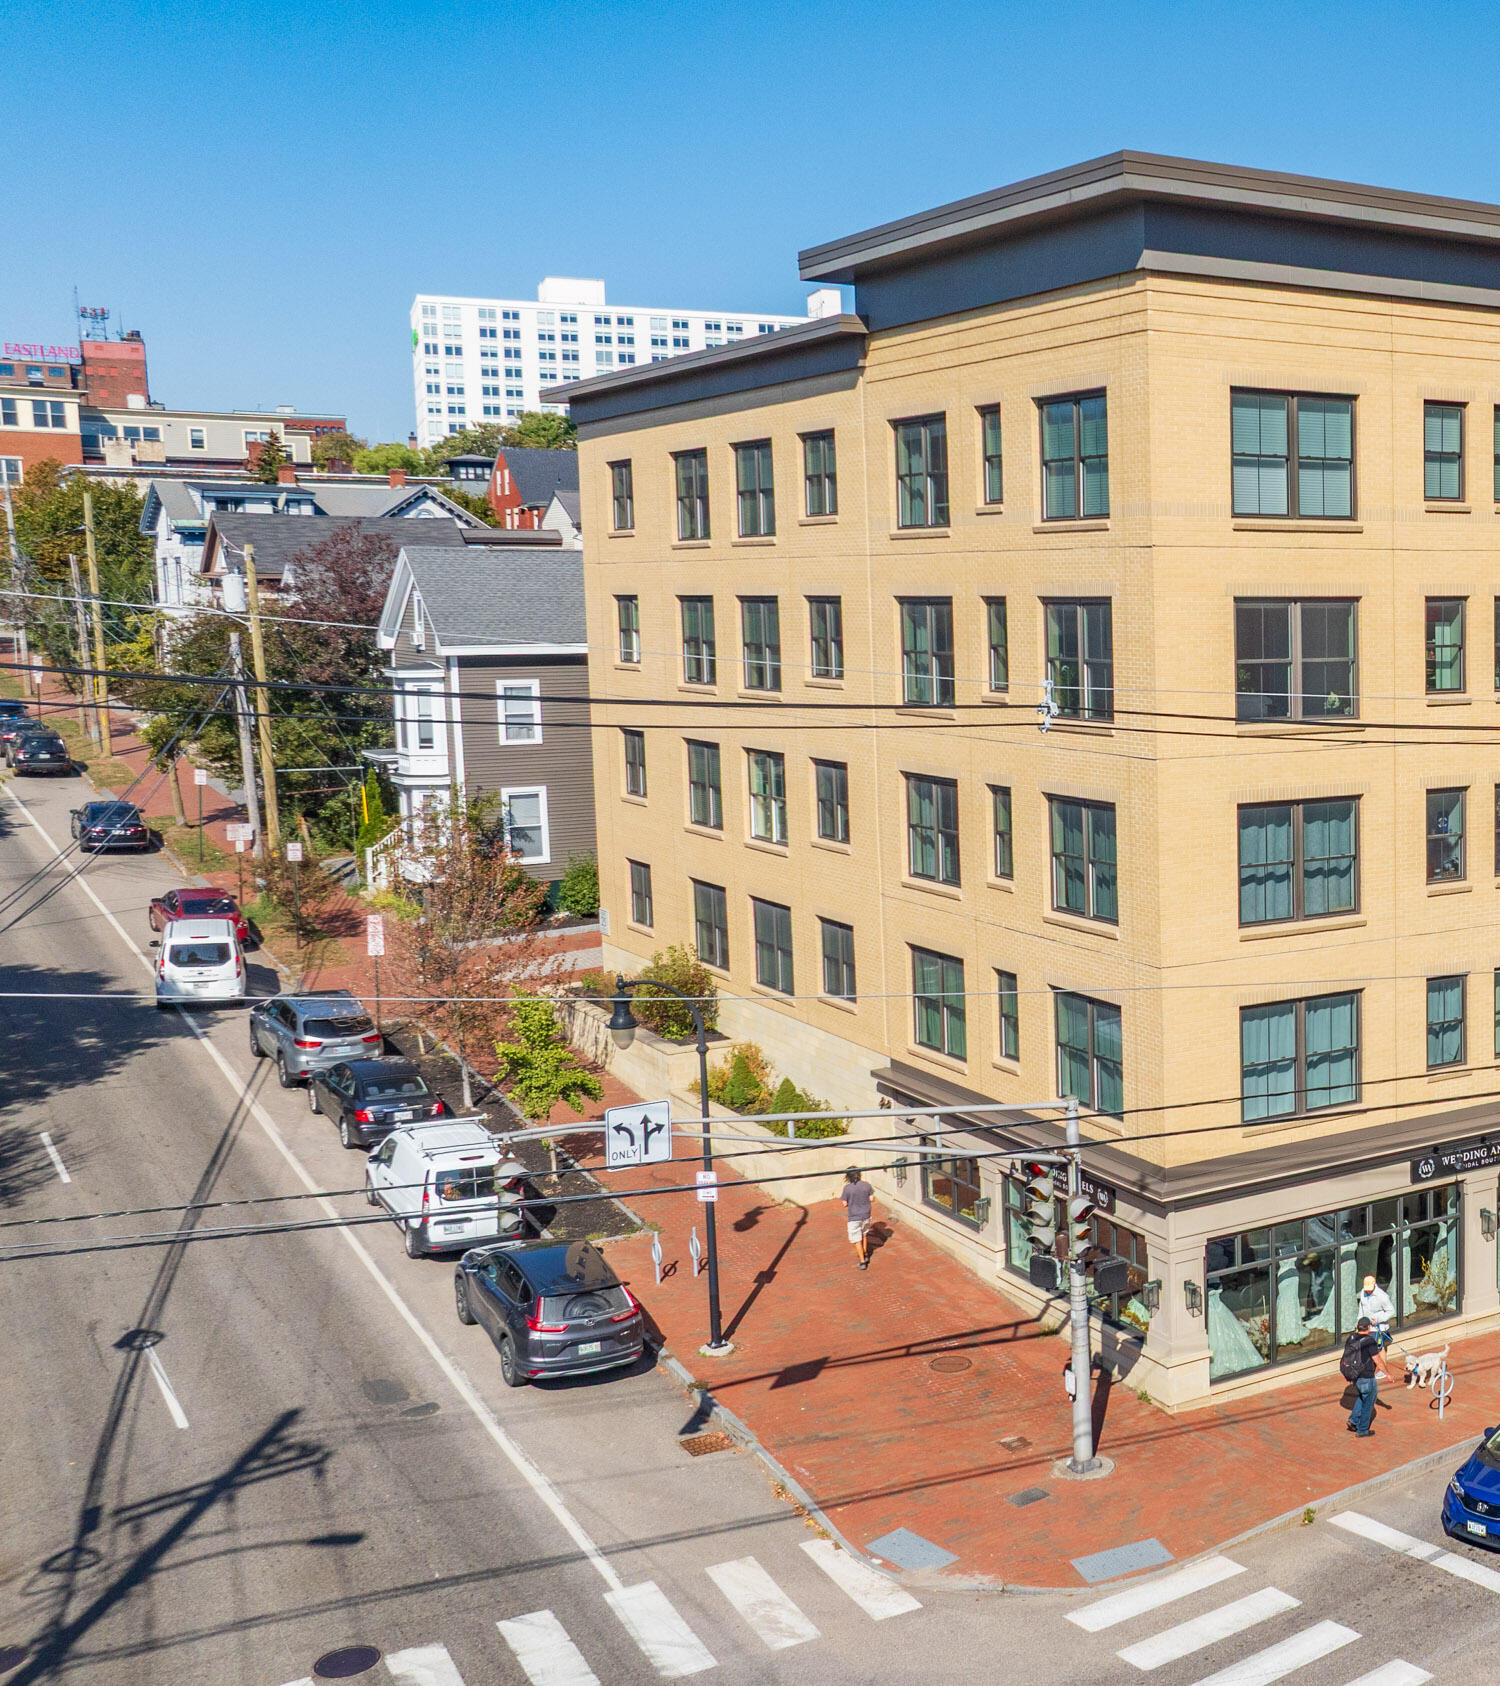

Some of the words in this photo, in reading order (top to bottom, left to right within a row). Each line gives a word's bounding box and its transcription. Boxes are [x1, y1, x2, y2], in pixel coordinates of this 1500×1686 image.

[4, 342, 79, 358] EASTLAND
[611, 1148, 638, 1161] ONLY
[1081, 1181, 1094, 1194] ELS
